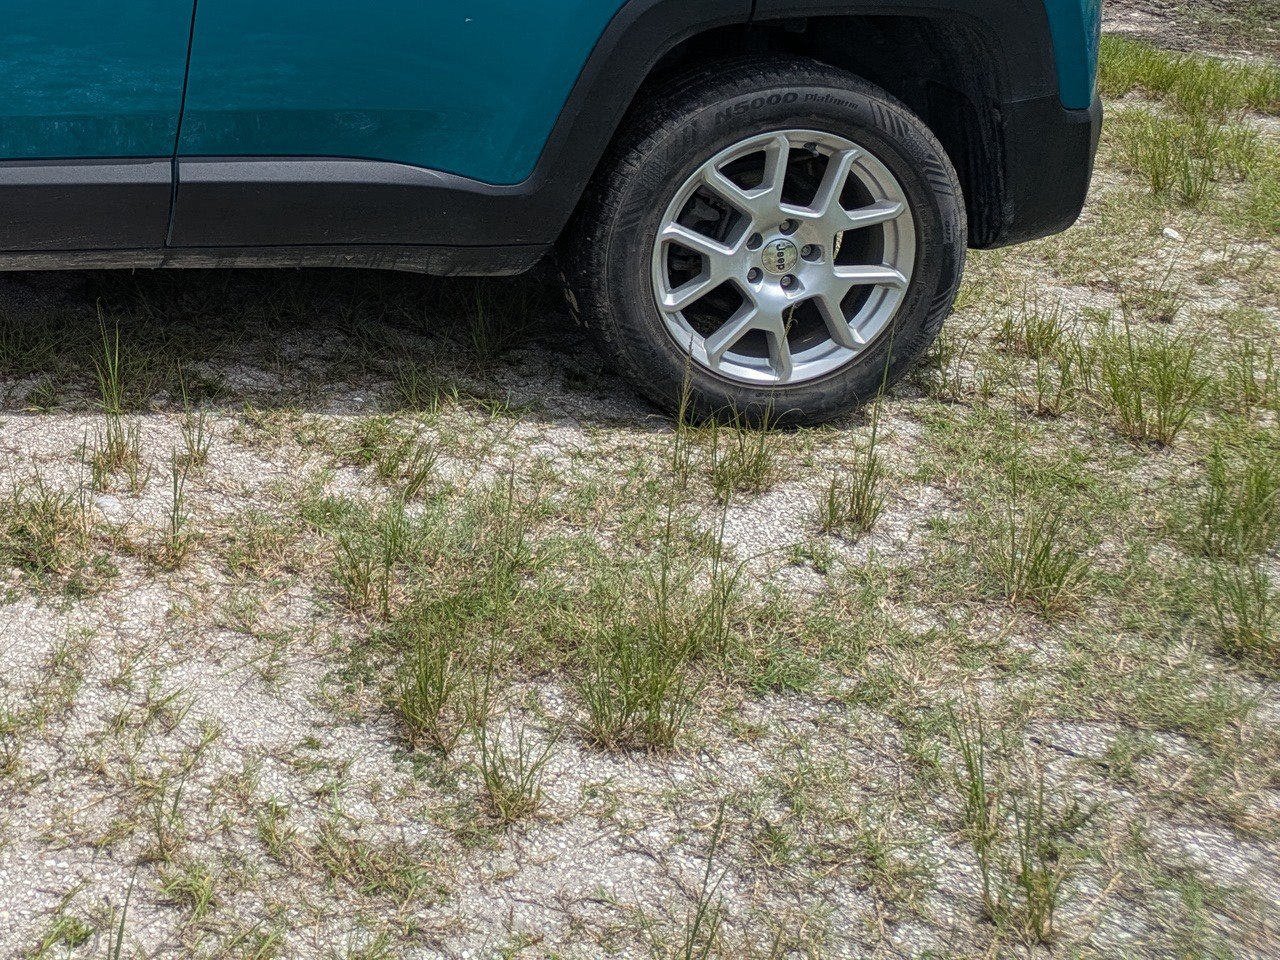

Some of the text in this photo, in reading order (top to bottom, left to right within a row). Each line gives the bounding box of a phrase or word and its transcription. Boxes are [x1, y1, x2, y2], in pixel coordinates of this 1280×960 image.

[714, 92, 860, 125] N5000 Platinum
[776, 243, 786, 271] Jeep
